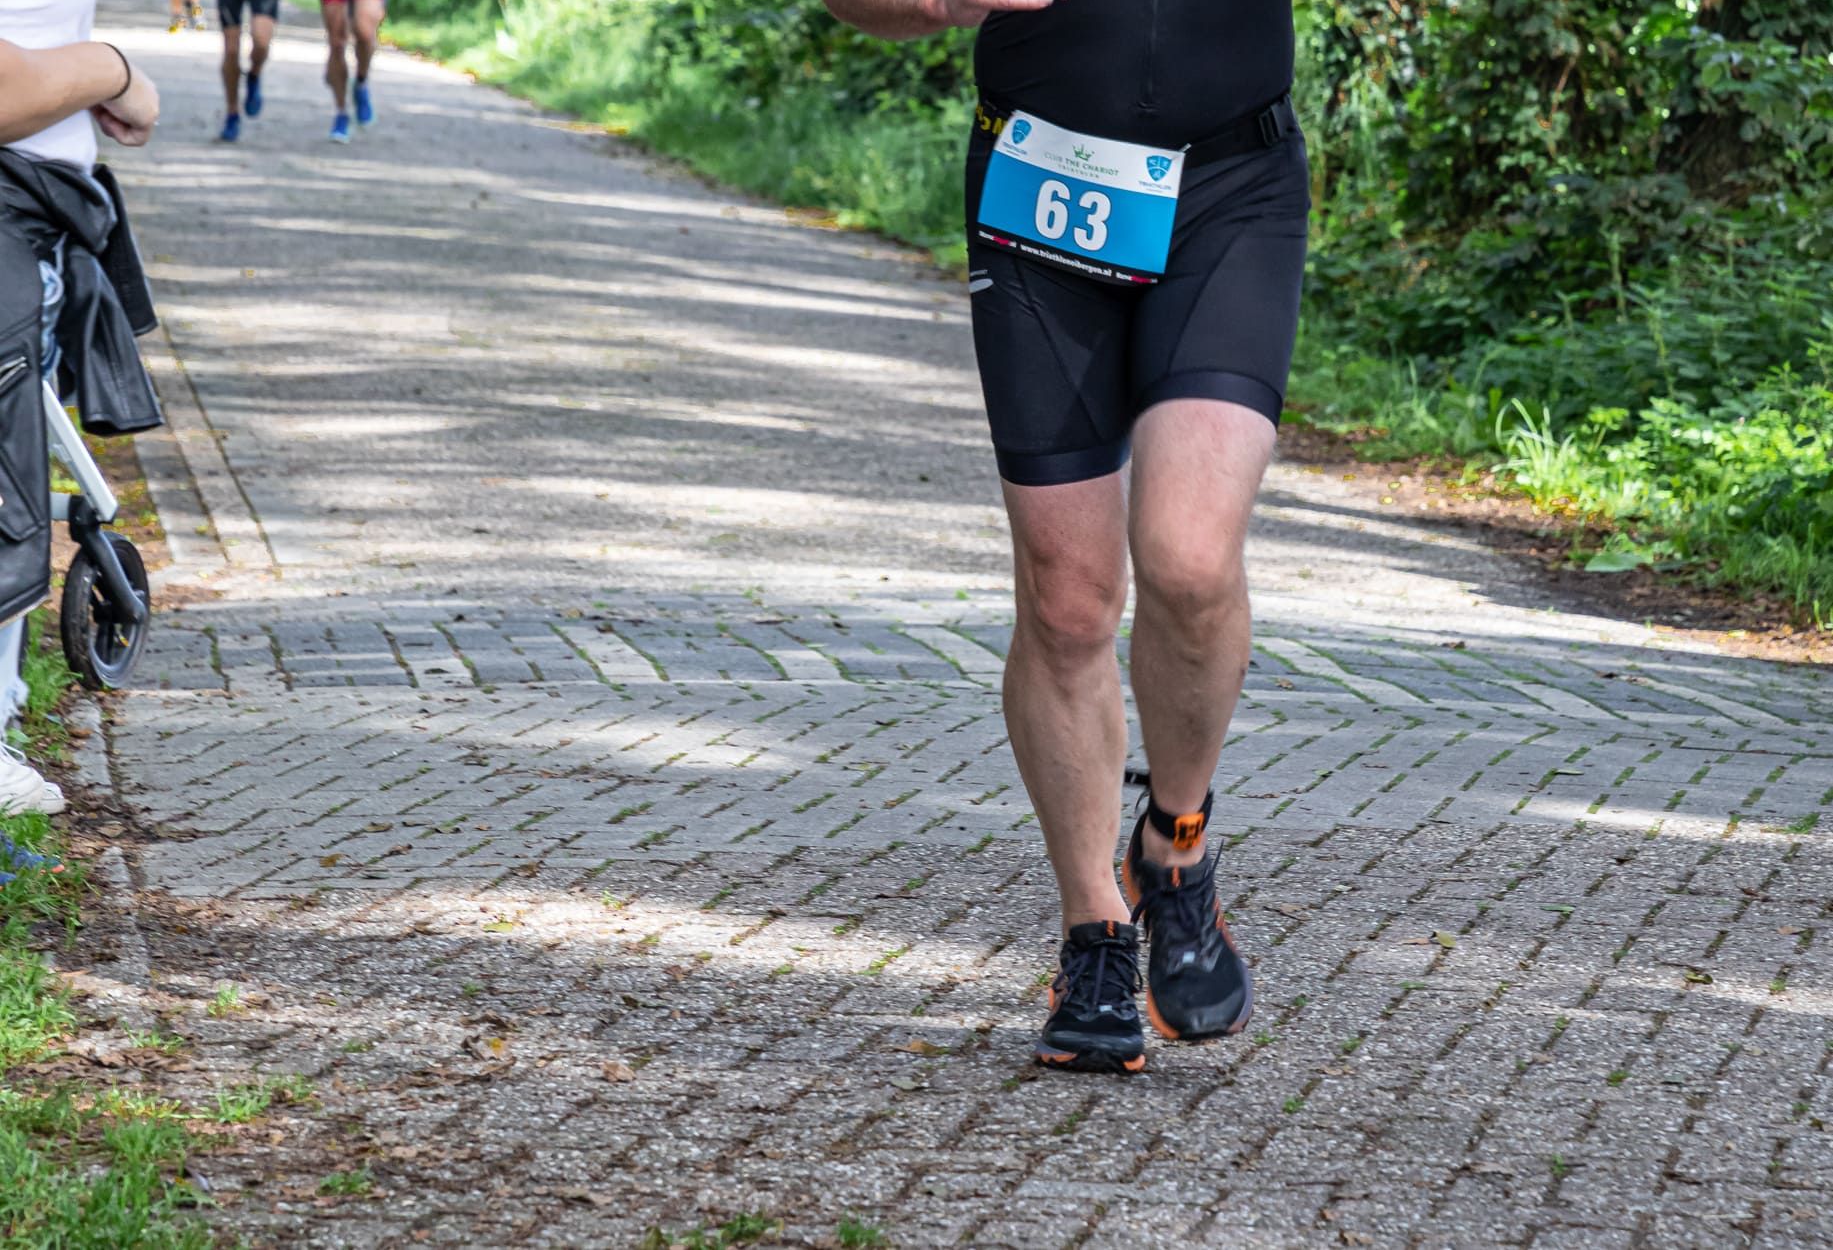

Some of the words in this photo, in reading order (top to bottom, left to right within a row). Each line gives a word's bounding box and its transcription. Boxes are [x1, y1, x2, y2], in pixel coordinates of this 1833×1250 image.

[1065, 157, 1081, 168] THE
[1082, 162, 1120, 177] CHARIOT
[1035, 179, 1112, 251] 63
